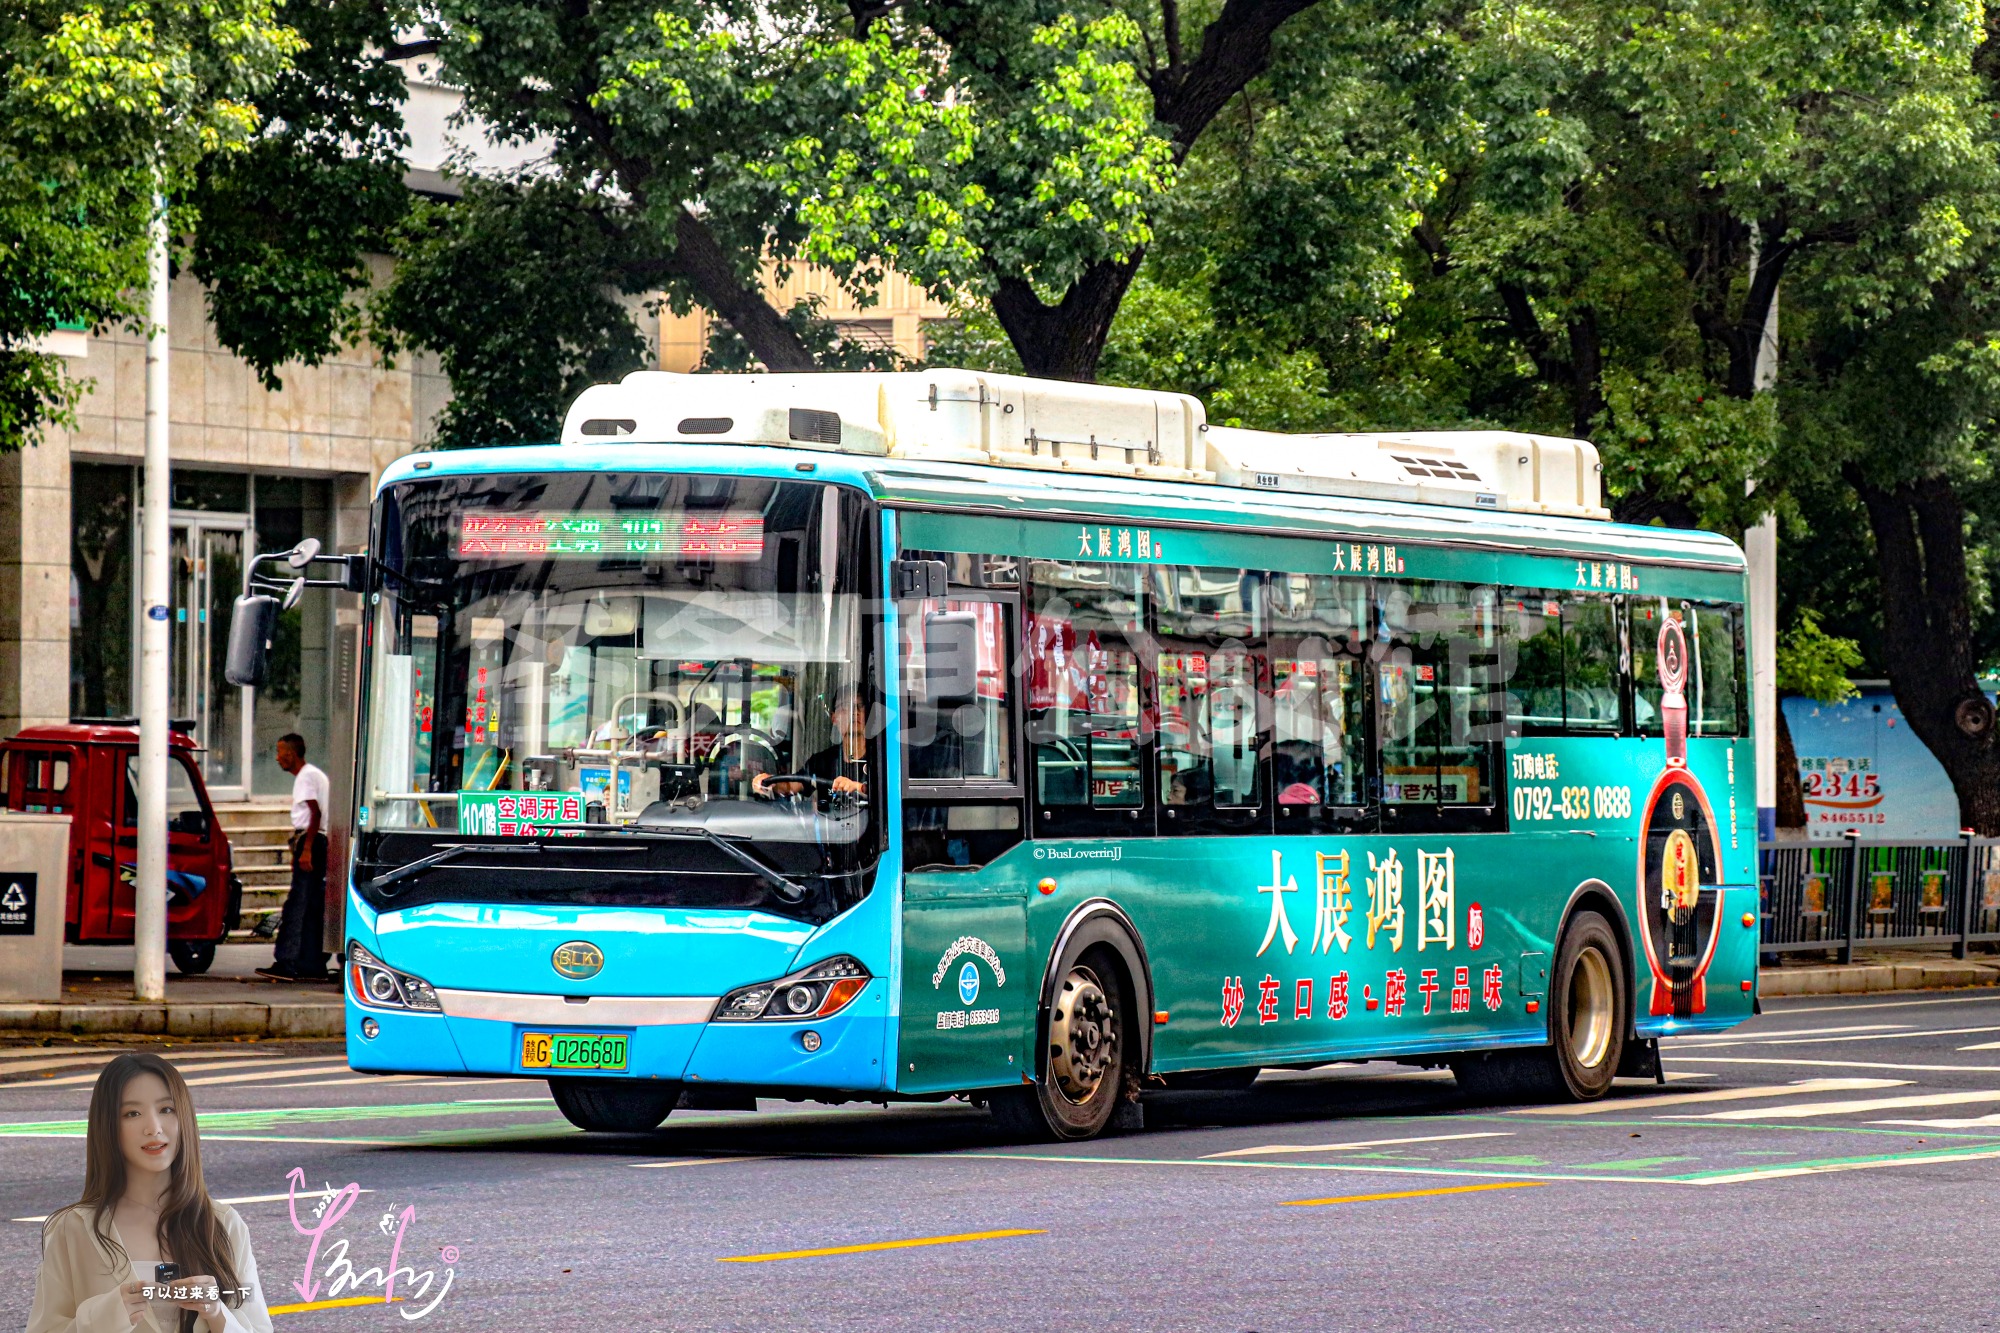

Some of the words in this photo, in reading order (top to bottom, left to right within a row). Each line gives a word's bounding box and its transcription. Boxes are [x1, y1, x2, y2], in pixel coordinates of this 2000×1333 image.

[1077, 526, 1151, 559] 大展鸿图
[1332, 543, 1398, 574] 大展鸿图
[1575, 561, 1632, 591] 大展鸿图
[498, 796, 580, 821] 空调开启
[1514, 786, 1590, 820] 0792-833
[1594, 785, 1632, 818] 0888
[1256, 847, 1455, 958] 大展鸿图
